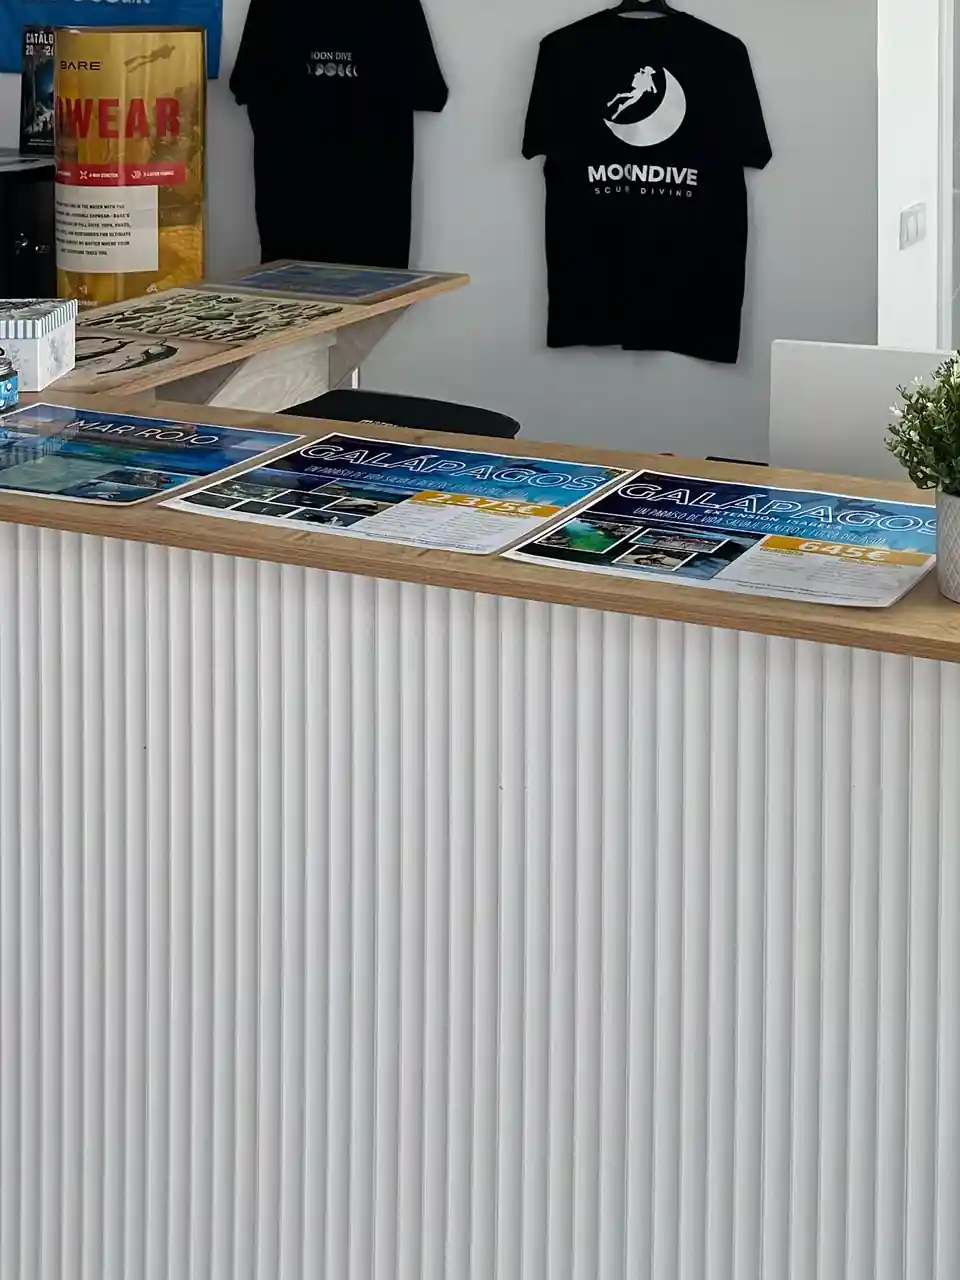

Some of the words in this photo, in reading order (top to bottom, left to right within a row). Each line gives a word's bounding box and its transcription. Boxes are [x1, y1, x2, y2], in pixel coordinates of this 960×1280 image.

[61, 61, 101, 71] BARE
[640, 187, 693, 198] DIVING
[66, 420, 135, 436] MAR
[135, 428, 219, 445] ROJO
[799, 542, 890, 561] 645€
